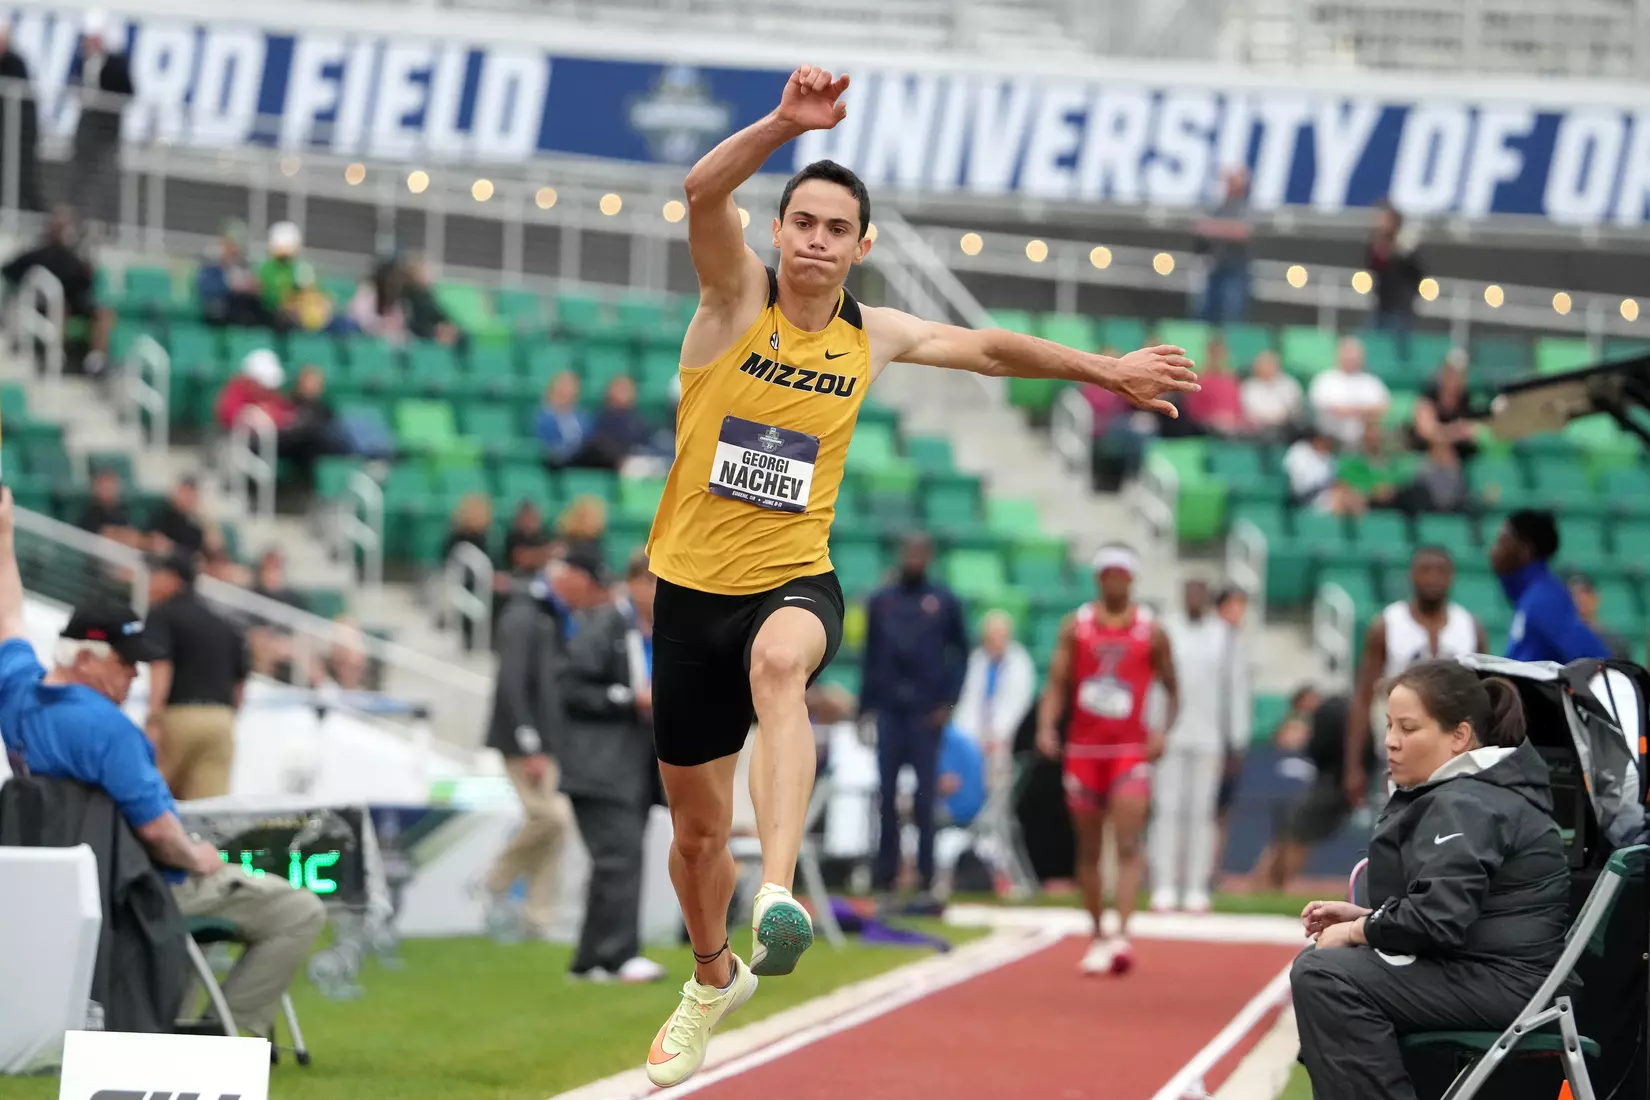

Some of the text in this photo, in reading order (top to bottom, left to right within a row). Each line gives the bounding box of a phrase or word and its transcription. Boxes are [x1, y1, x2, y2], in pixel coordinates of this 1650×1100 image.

[278, 35, 549, 162] FIELD
[1389, 103, 1538, 221] OF
[739, 351, 857, 398] MIZZOU
[718, 460, 804, 501] NACHEV
[742, 450, 790, 474] GEORGI
